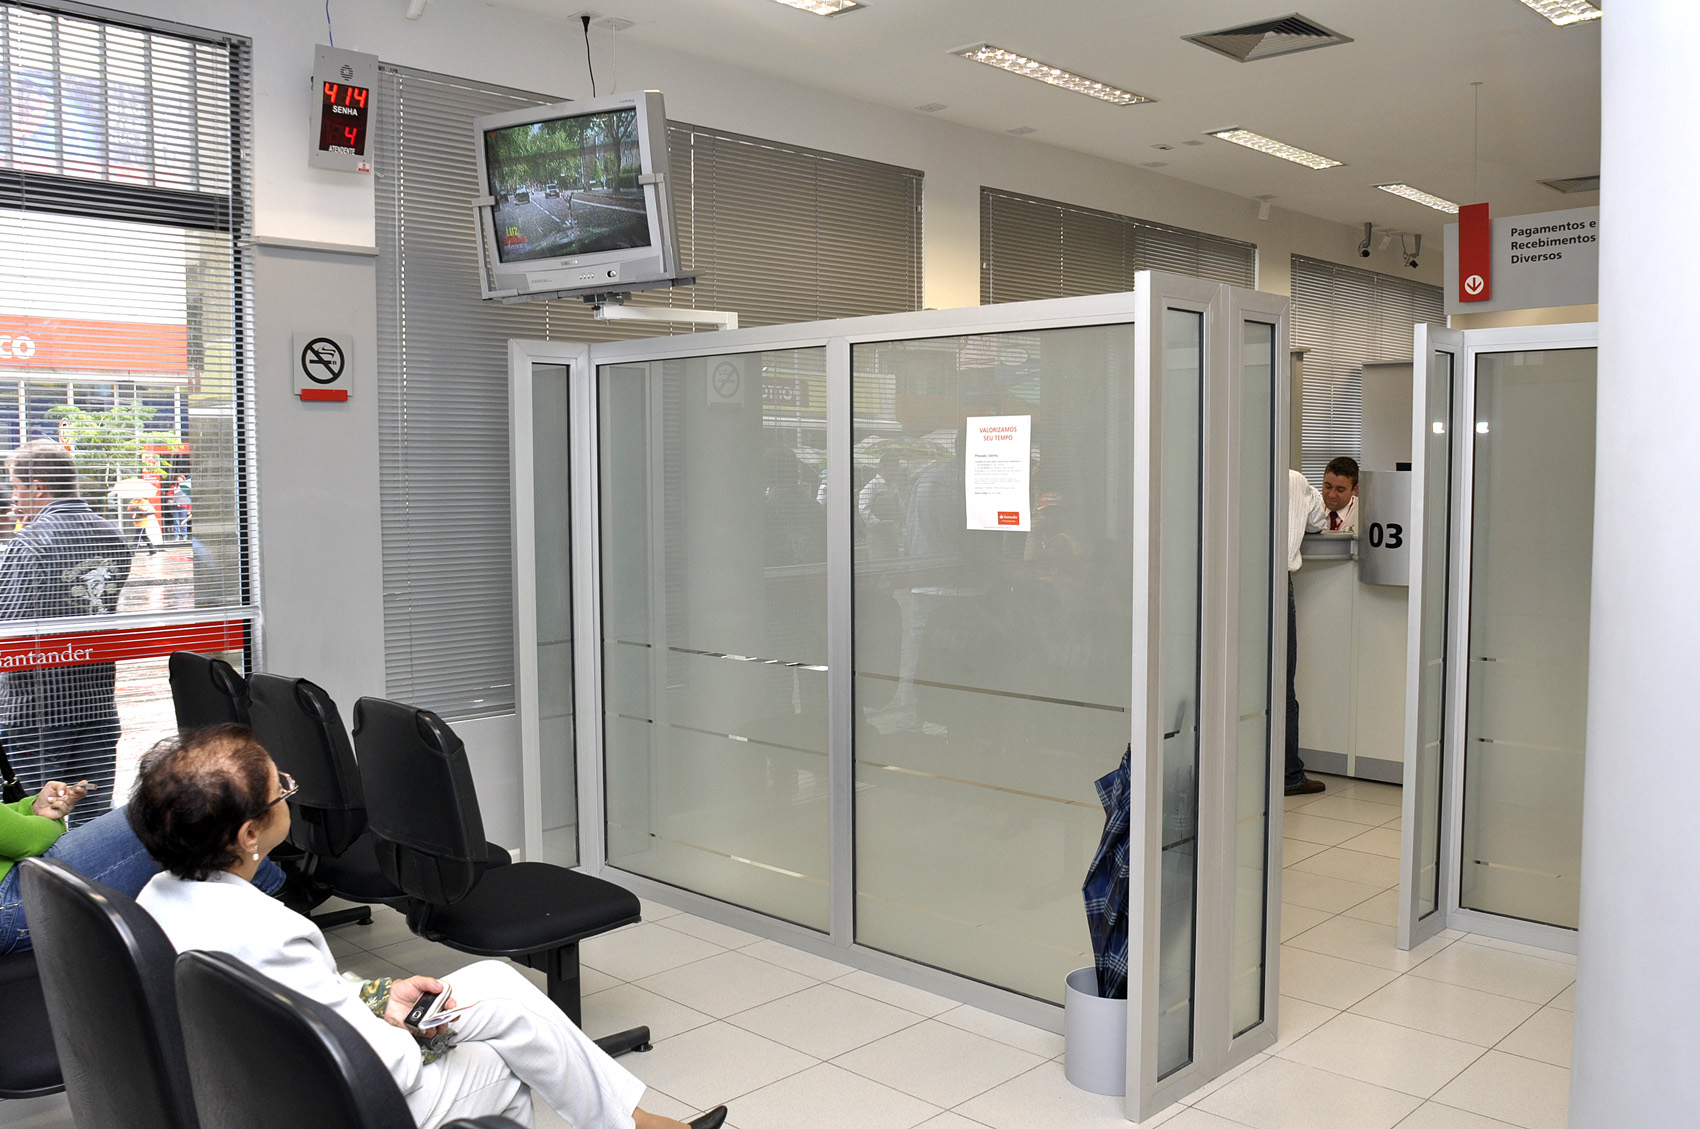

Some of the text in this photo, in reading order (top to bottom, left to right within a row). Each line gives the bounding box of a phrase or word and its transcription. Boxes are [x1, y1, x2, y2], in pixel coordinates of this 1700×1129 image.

[324, 82, 368, 109] 414
[332, 105, 358, 116] SENHA
[344, 126, 358, 146] 4
[1510, 220, 1597, 238] Pagamentos e
[1510, 234, 1597, 251] Recebimentos
[1510, 251, 1563, 264] Diversos
[1369, 522, 1403, 549] 03
[0, 642, 93, 668] antander
